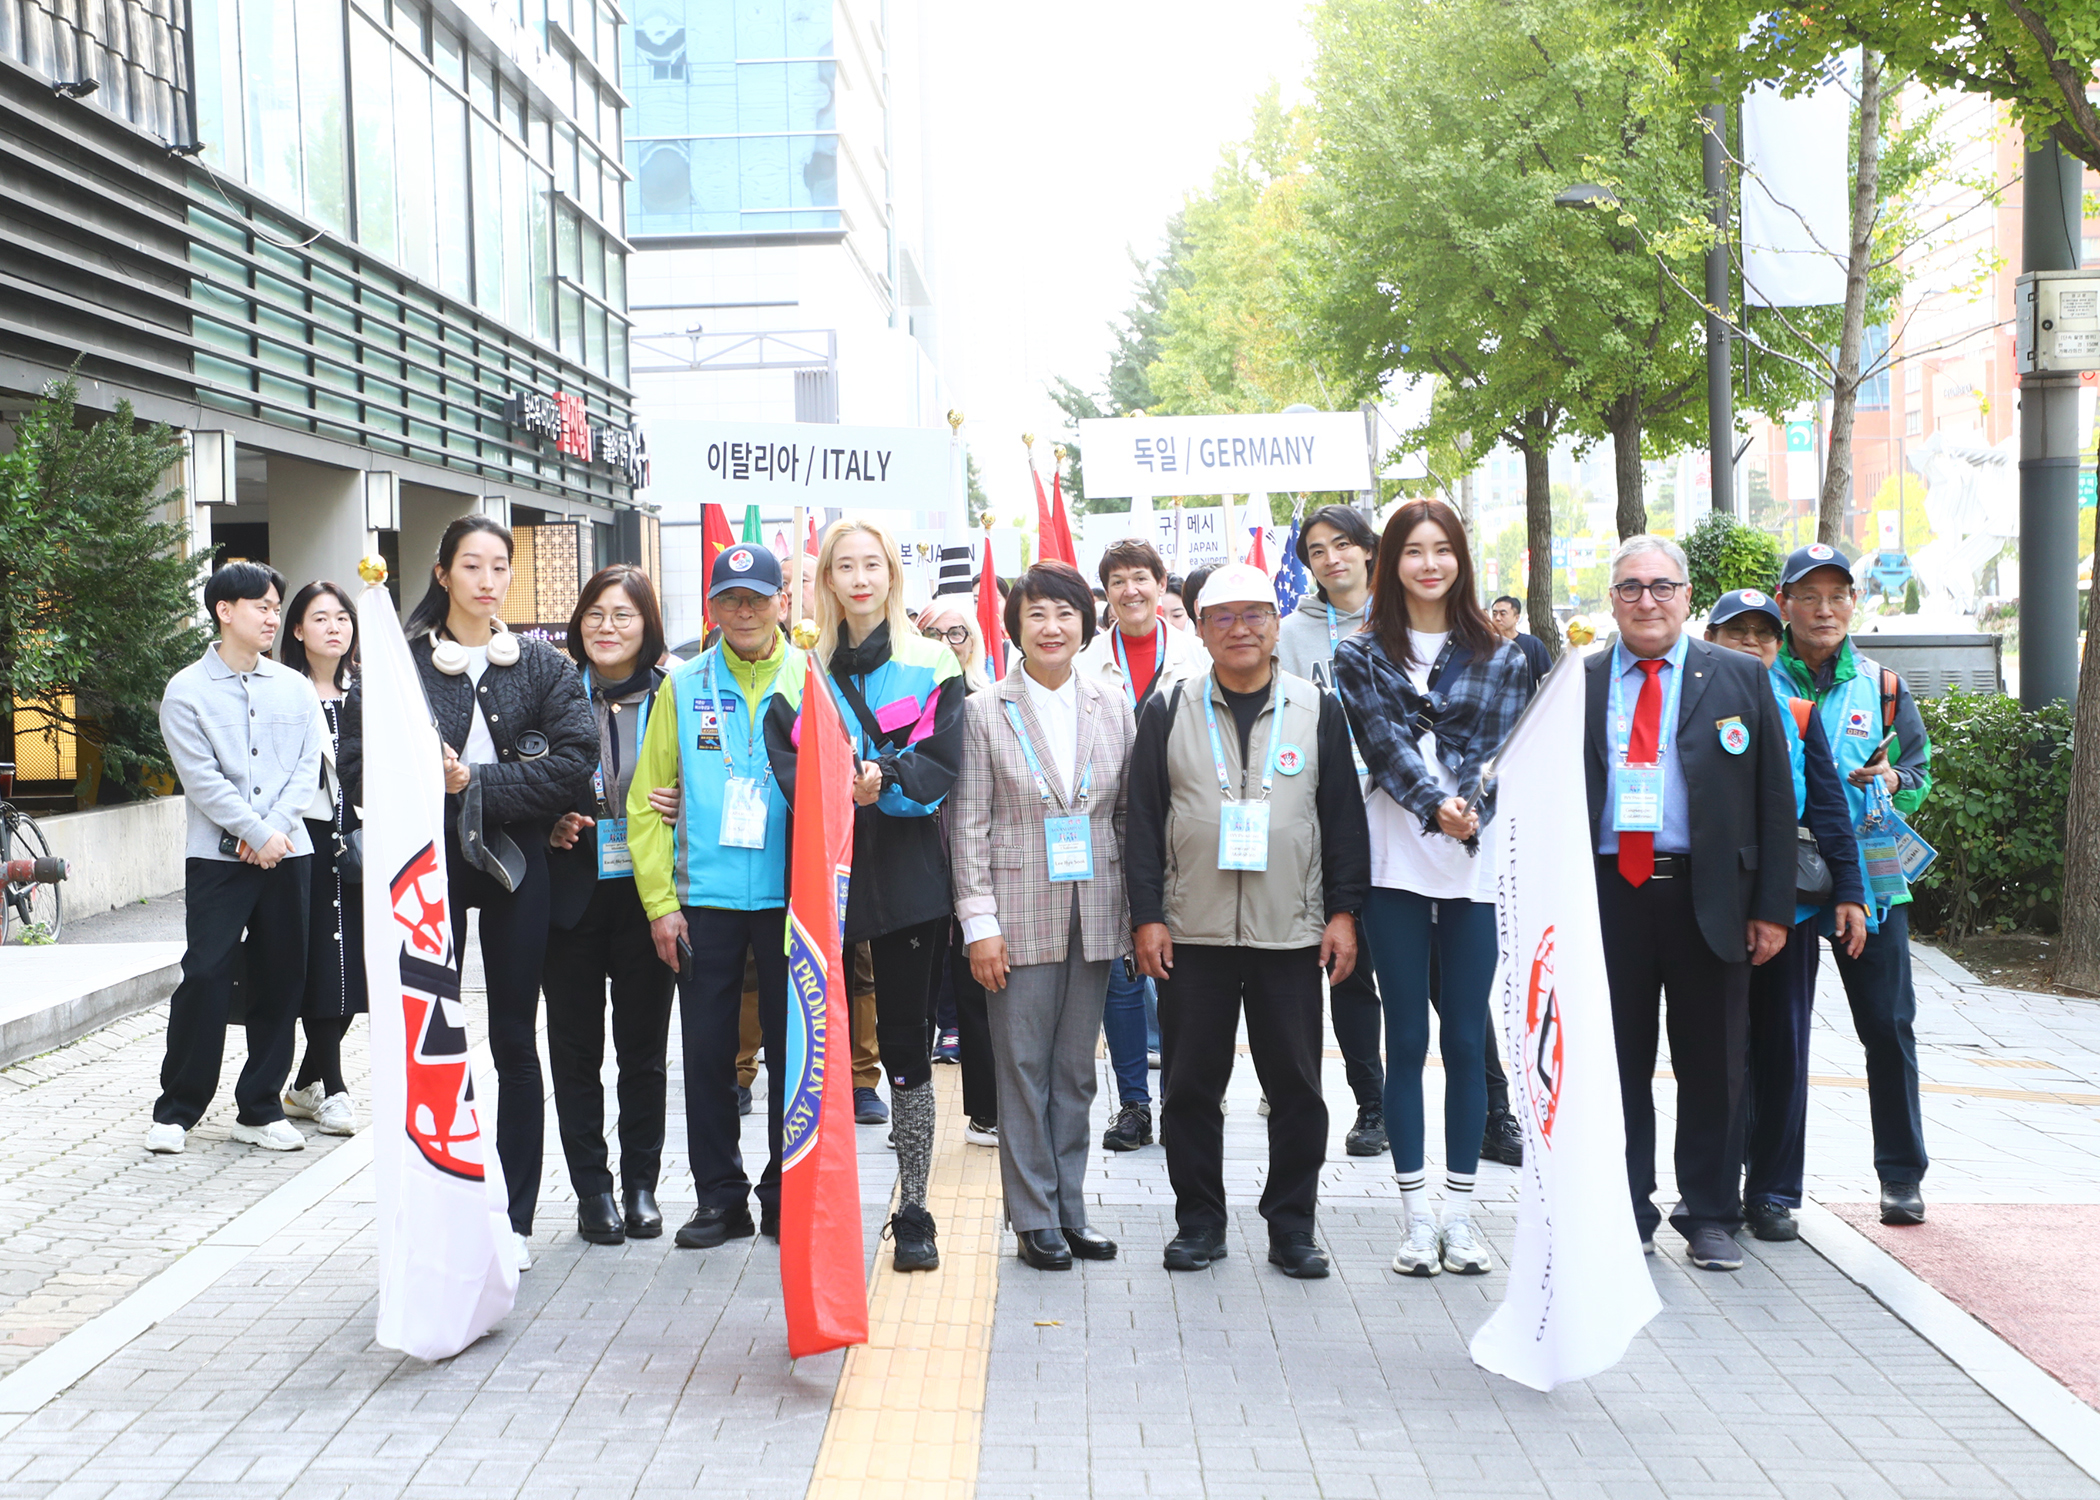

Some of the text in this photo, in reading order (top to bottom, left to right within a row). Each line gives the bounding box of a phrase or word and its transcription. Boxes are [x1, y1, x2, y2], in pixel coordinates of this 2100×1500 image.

[707, 441, 799, 482] 이탈리아
[822, 448, 892, 482] ITALY
[1134, 436, 1177, 473] 독일
[1200, 435, 1315, 468] GERMANY
[1188, 541, 1218, 553] JAPAN
[1846, 728, 1868, 738] OREA
[1497, 874, 1511, 966] KOREA
